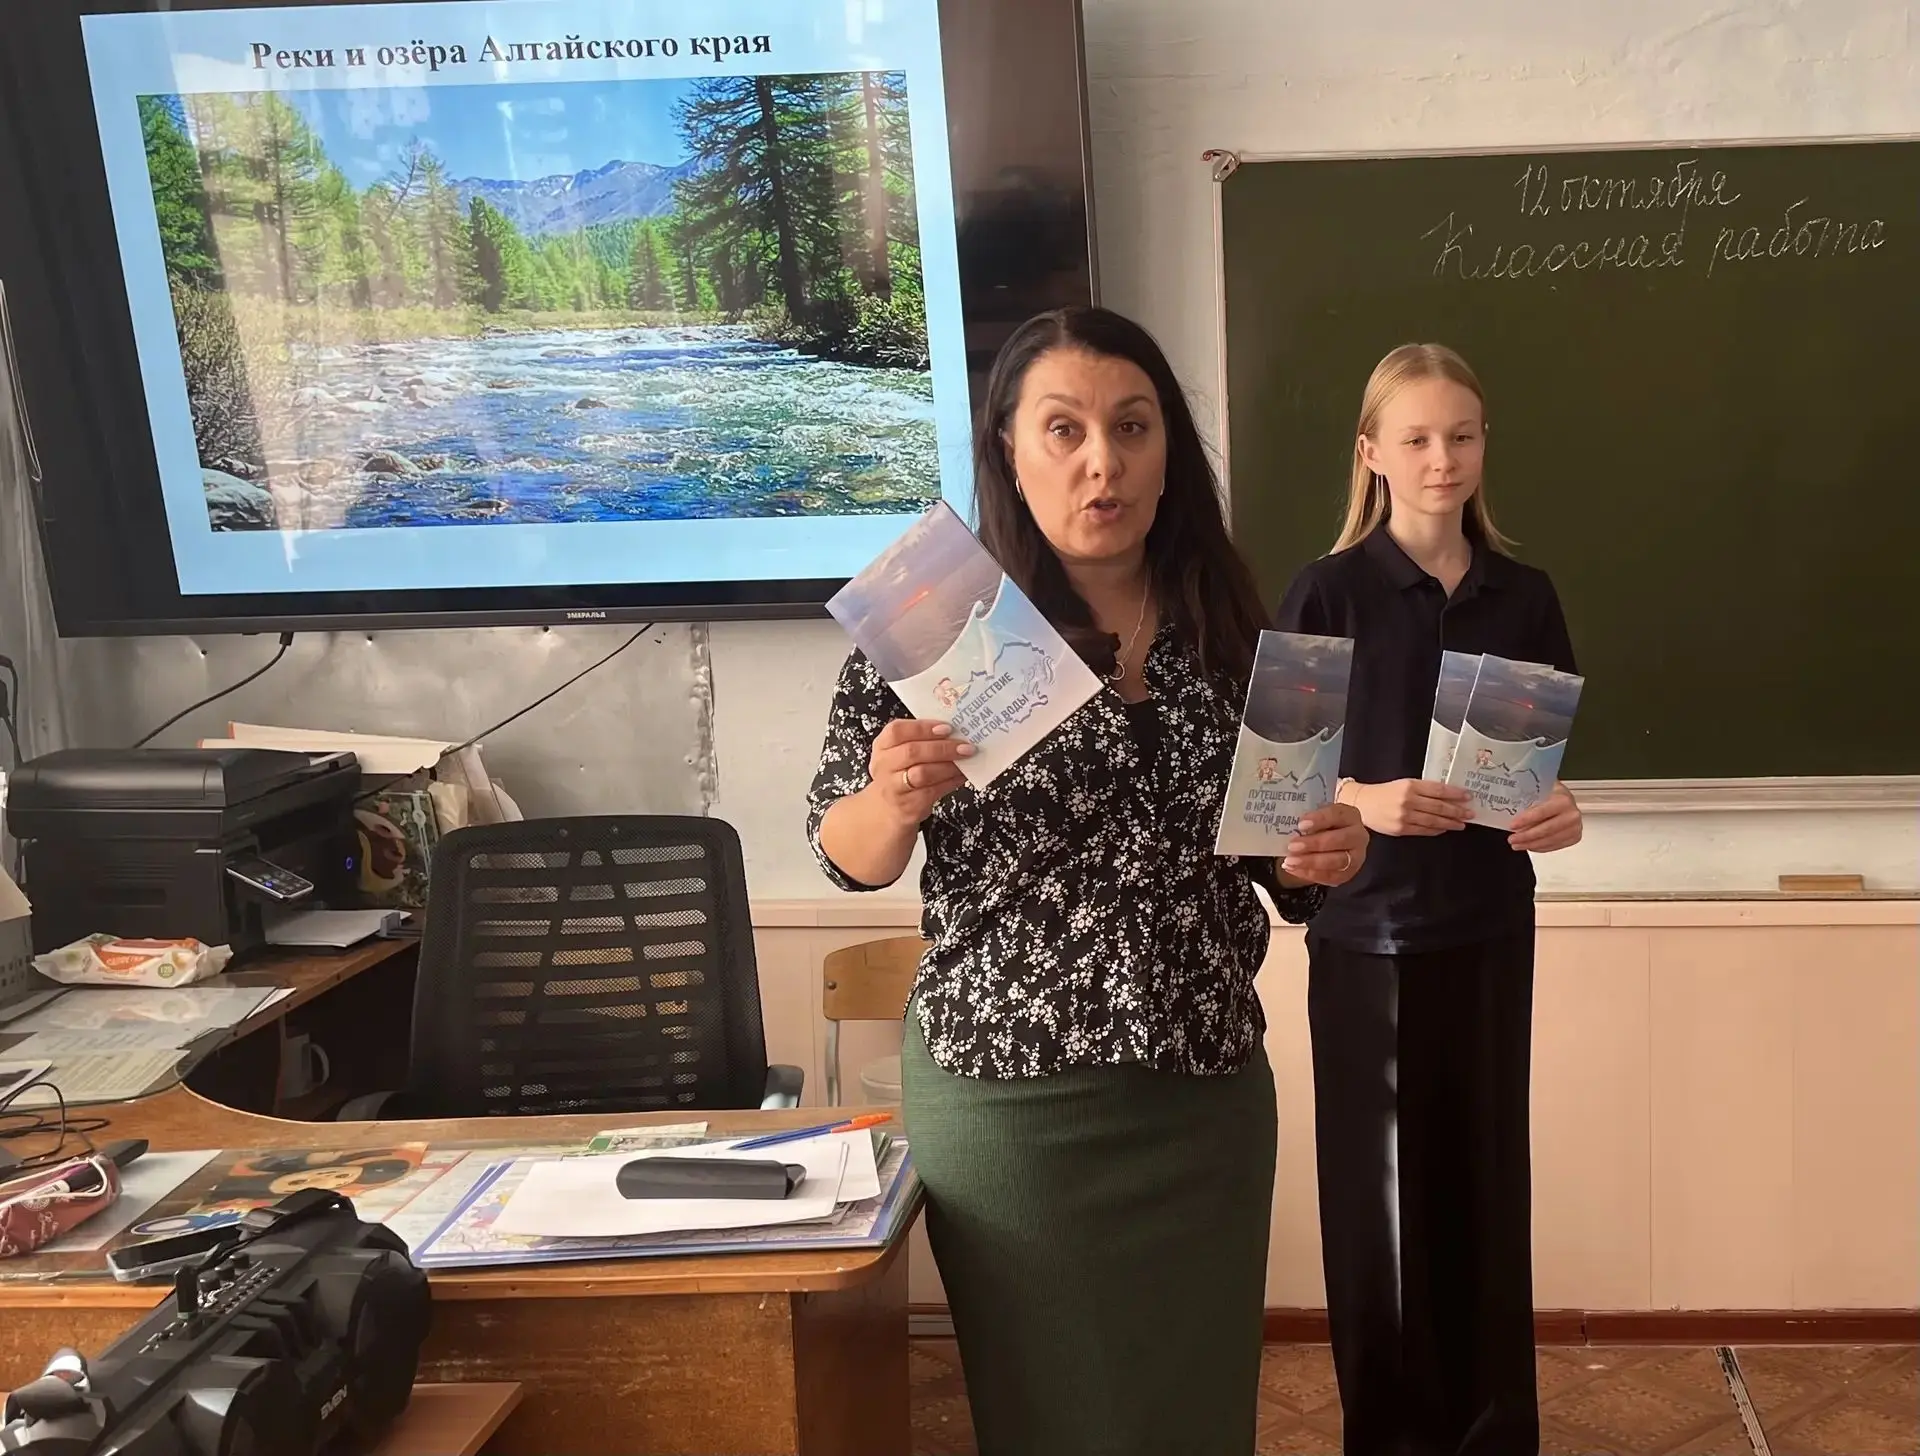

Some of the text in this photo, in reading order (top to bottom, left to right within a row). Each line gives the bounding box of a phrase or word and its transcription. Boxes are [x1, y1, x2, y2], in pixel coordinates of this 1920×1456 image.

[250, 33, 772, 72] Реки и озёра Алтайского края
[1514, 158, 1741, 245] 12 октября
[1420, 197, 1886, 280] Классная работа
[952, 672, 1014, 728] ПУТЕШЕСТВИЕ
[960, 727, 970, 737] В
[969, 694, 1029, 744] ЧИСТОЙ ВОДЫ
[1248, 789, 1307, 802] ПУТЕШЕСТВИЕ
[1466, 770, 1518, 788] ПУТЕШЕСТВИЕ
[1243, 813, 1275, 824] ЧИСТОЙ
[1246, 801, 1253, 811] В
[320, 1384, 348, 1420] SVEN
